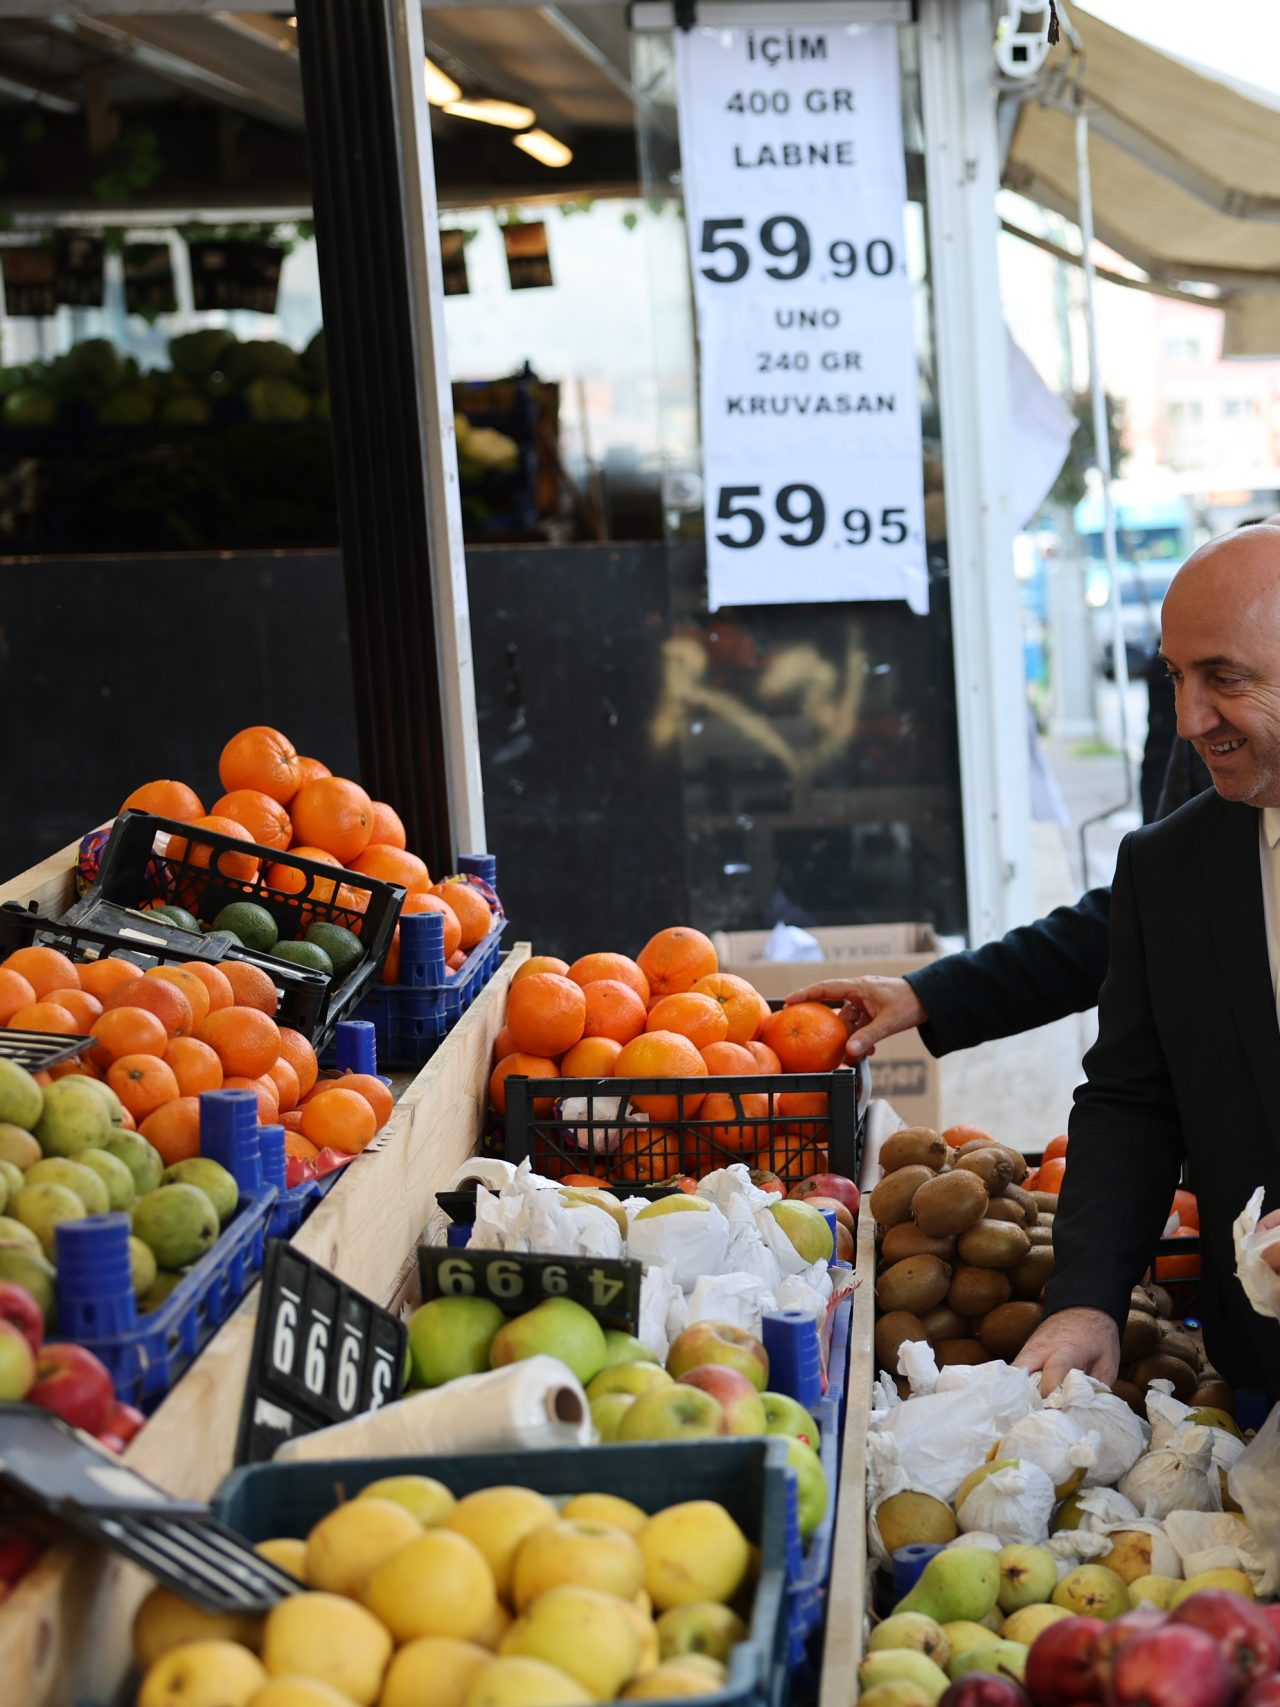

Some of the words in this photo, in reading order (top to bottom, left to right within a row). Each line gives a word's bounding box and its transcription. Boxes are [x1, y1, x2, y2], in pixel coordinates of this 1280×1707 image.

[747, 33, 828, 67] İÇİM
[726, 89, 790, 116] 400
[804, 89, 854, 114] GR
[734, 141, 856, 169] LABNE
[775, 309, 841, 329] UNO
[756, 352, 811, 373] 240
[820, 352, 863, 371] GR
[726, 394, 897, 416] KRUVASAN
